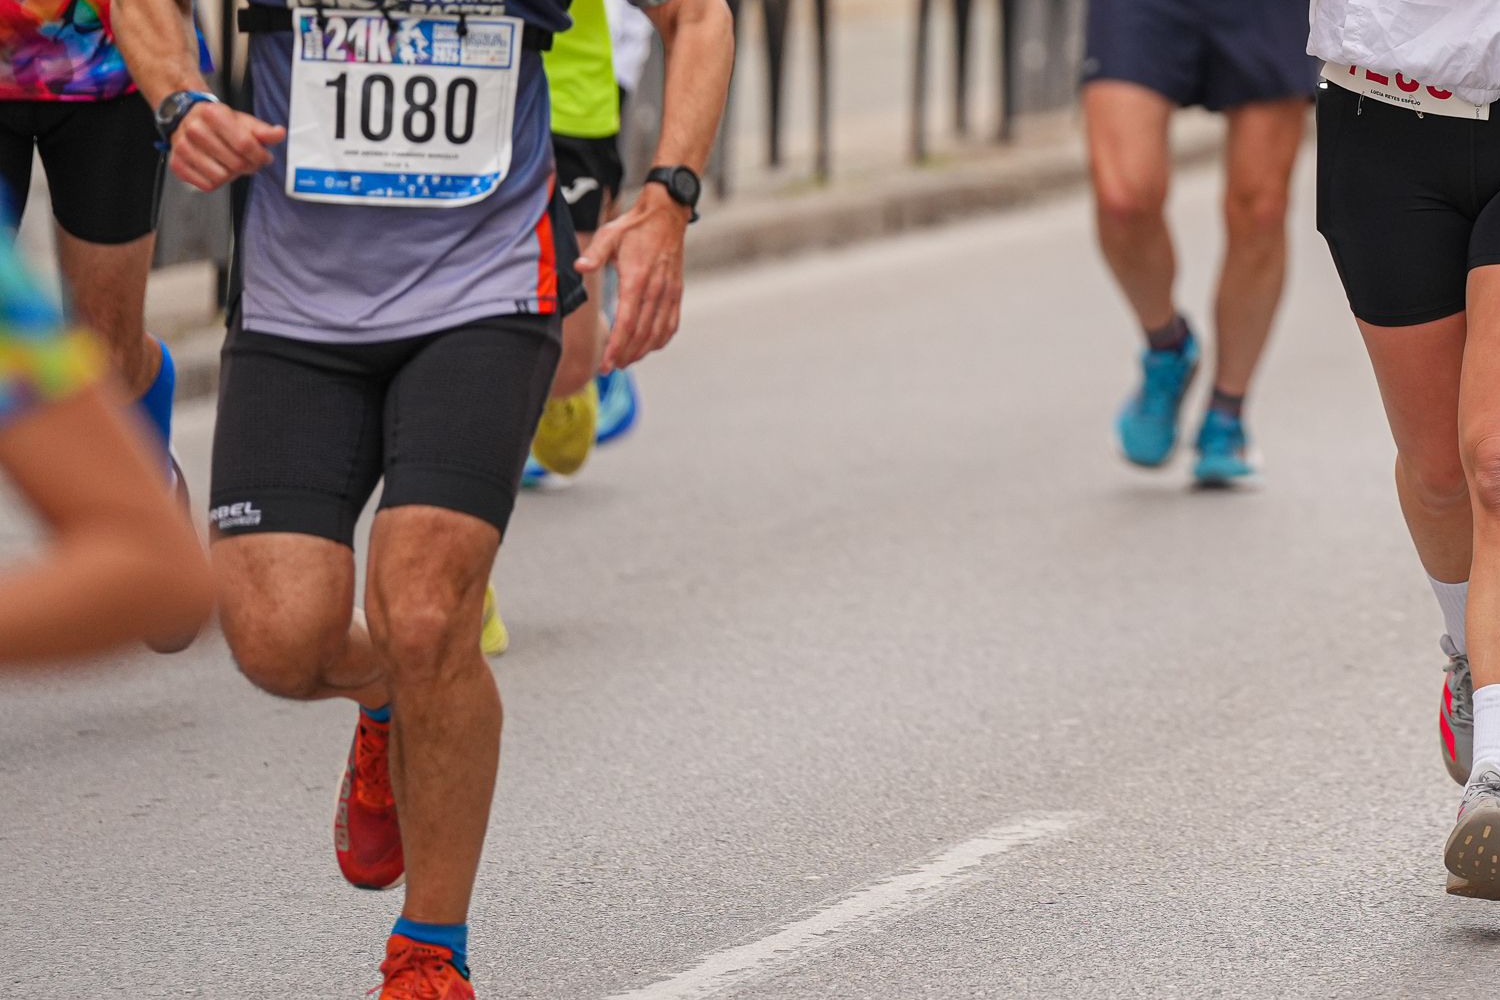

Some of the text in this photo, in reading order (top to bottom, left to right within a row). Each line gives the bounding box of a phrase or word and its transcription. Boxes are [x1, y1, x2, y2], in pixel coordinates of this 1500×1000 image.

[326, 16, 393, 62] 21K
[326, 72, 477, 144] 1080
[1385, 94, 1400, 102] REYES
[1401, 98, 1420, 106] ESPEJO
